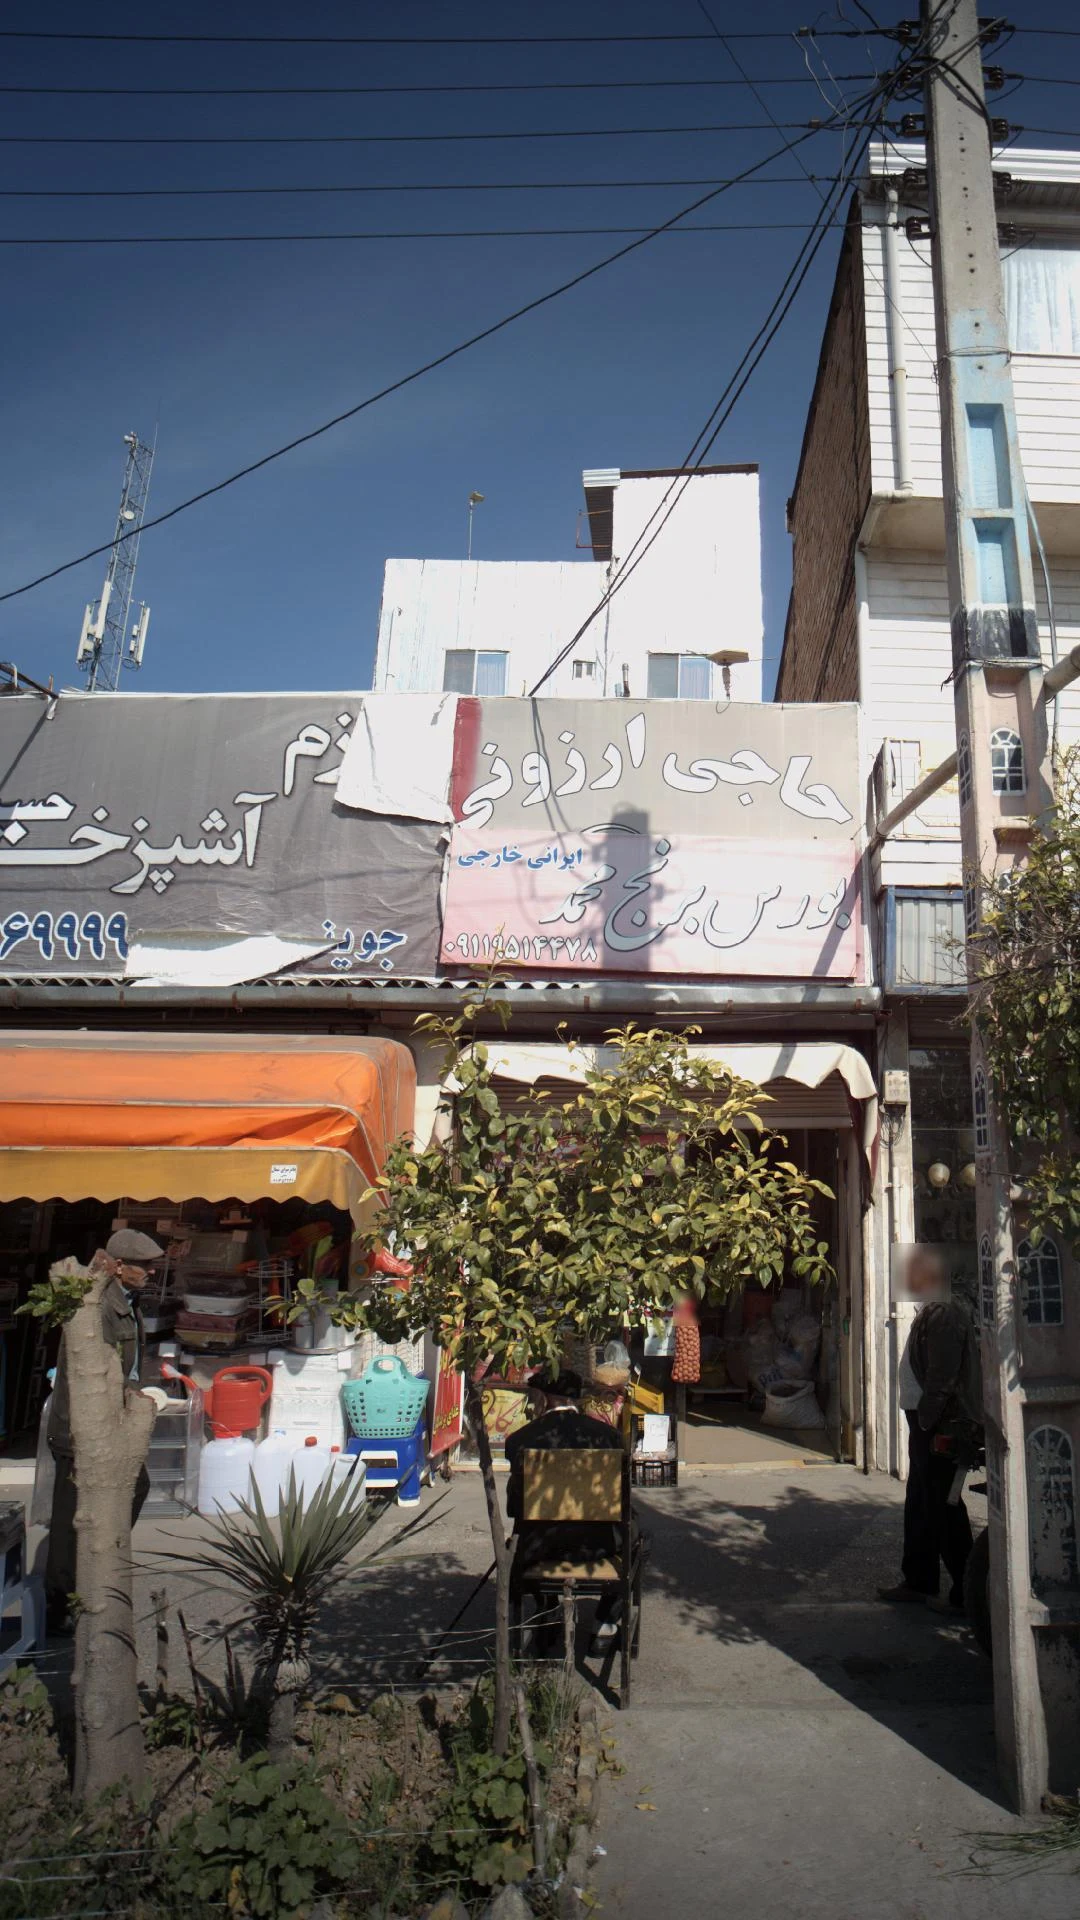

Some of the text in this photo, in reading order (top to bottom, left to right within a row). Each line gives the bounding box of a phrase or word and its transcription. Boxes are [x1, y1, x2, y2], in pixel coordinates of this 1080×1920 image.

[460, 712, 854, 830] حاجی ارزونی
[457, 845, 583, 871] ایرانی خارجی
[538, 838, 852, 953] بورس برنج محمد
[444, 932, 598, 963] ۰۹۱۱۹۵۱۴۴۷۸
